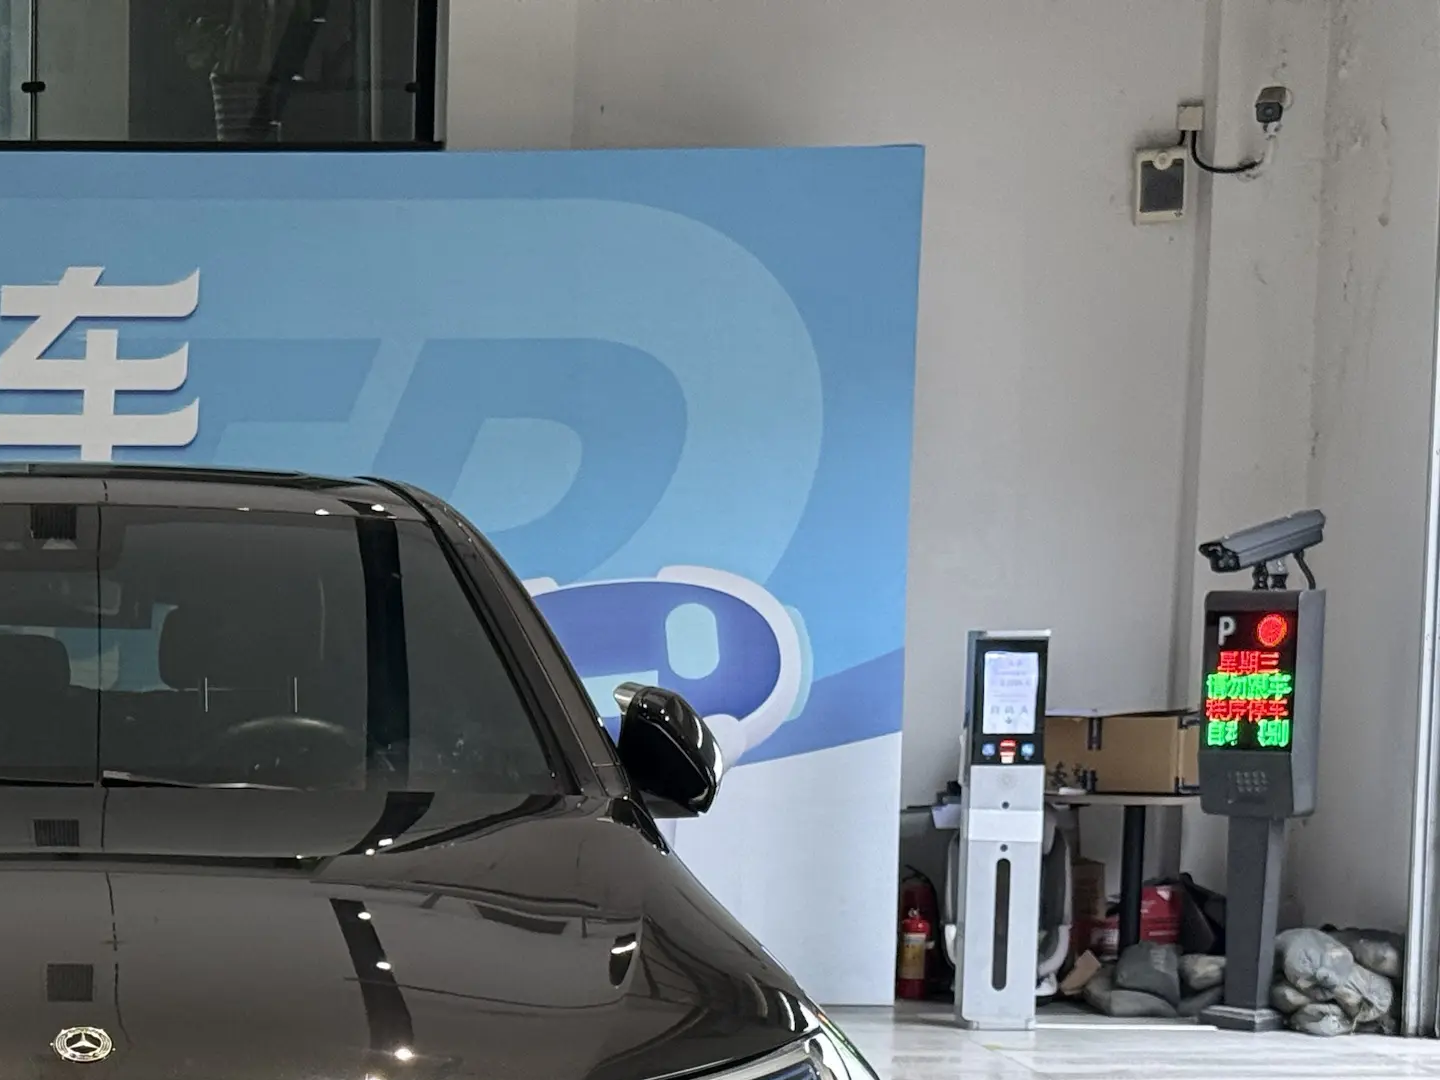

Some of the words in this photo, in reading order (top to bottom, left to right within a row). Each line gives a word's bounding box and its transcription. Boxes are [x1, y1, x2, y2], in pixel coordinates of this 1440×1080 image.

[1218, 616, 1237, 646] P
[1217, 651, 1280, 674] 星期三
[1206, 673, 1292, 699] 请勿跟车
[1206, 698, 1289, 722] 秩序停车
